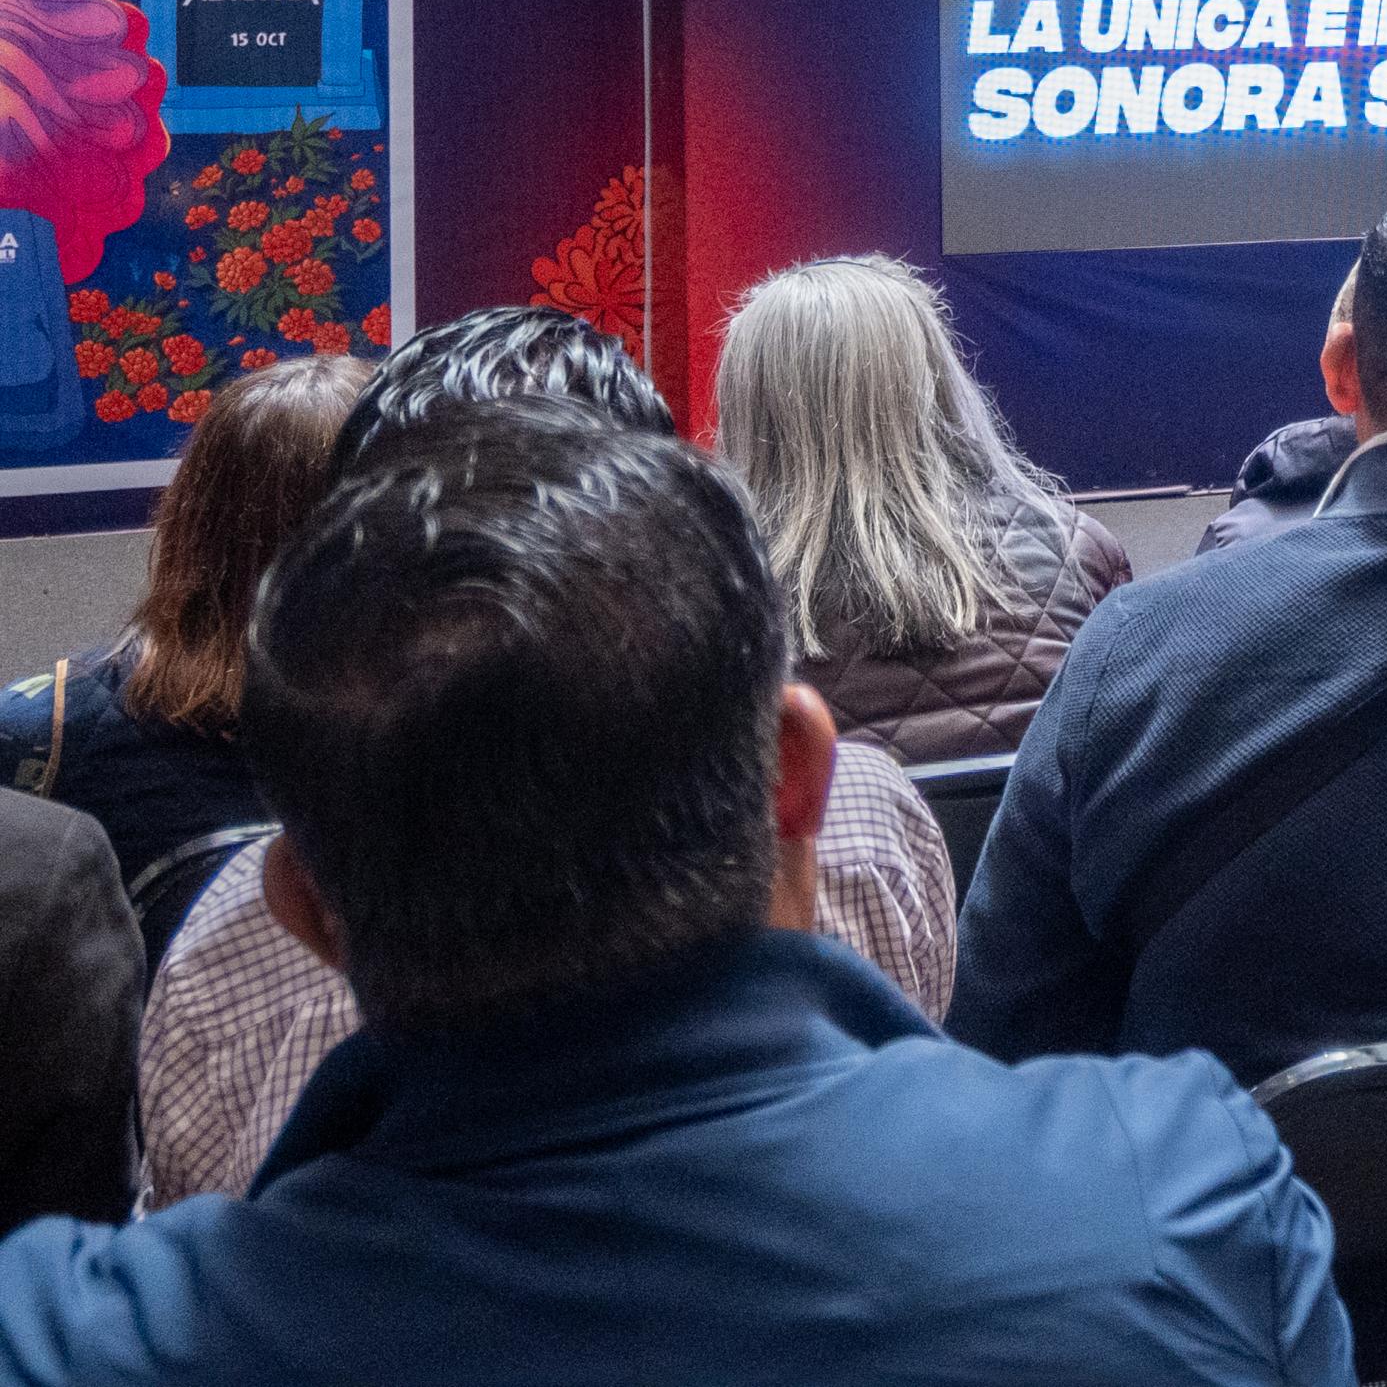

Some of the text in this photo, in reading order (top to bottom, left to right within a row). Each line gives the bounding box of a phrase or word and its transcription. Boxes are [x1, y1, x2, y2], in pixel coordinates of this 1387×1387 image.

[230, 32, 287, 47] 15 OCT
[967, 60, 1348, 141] SONORA
